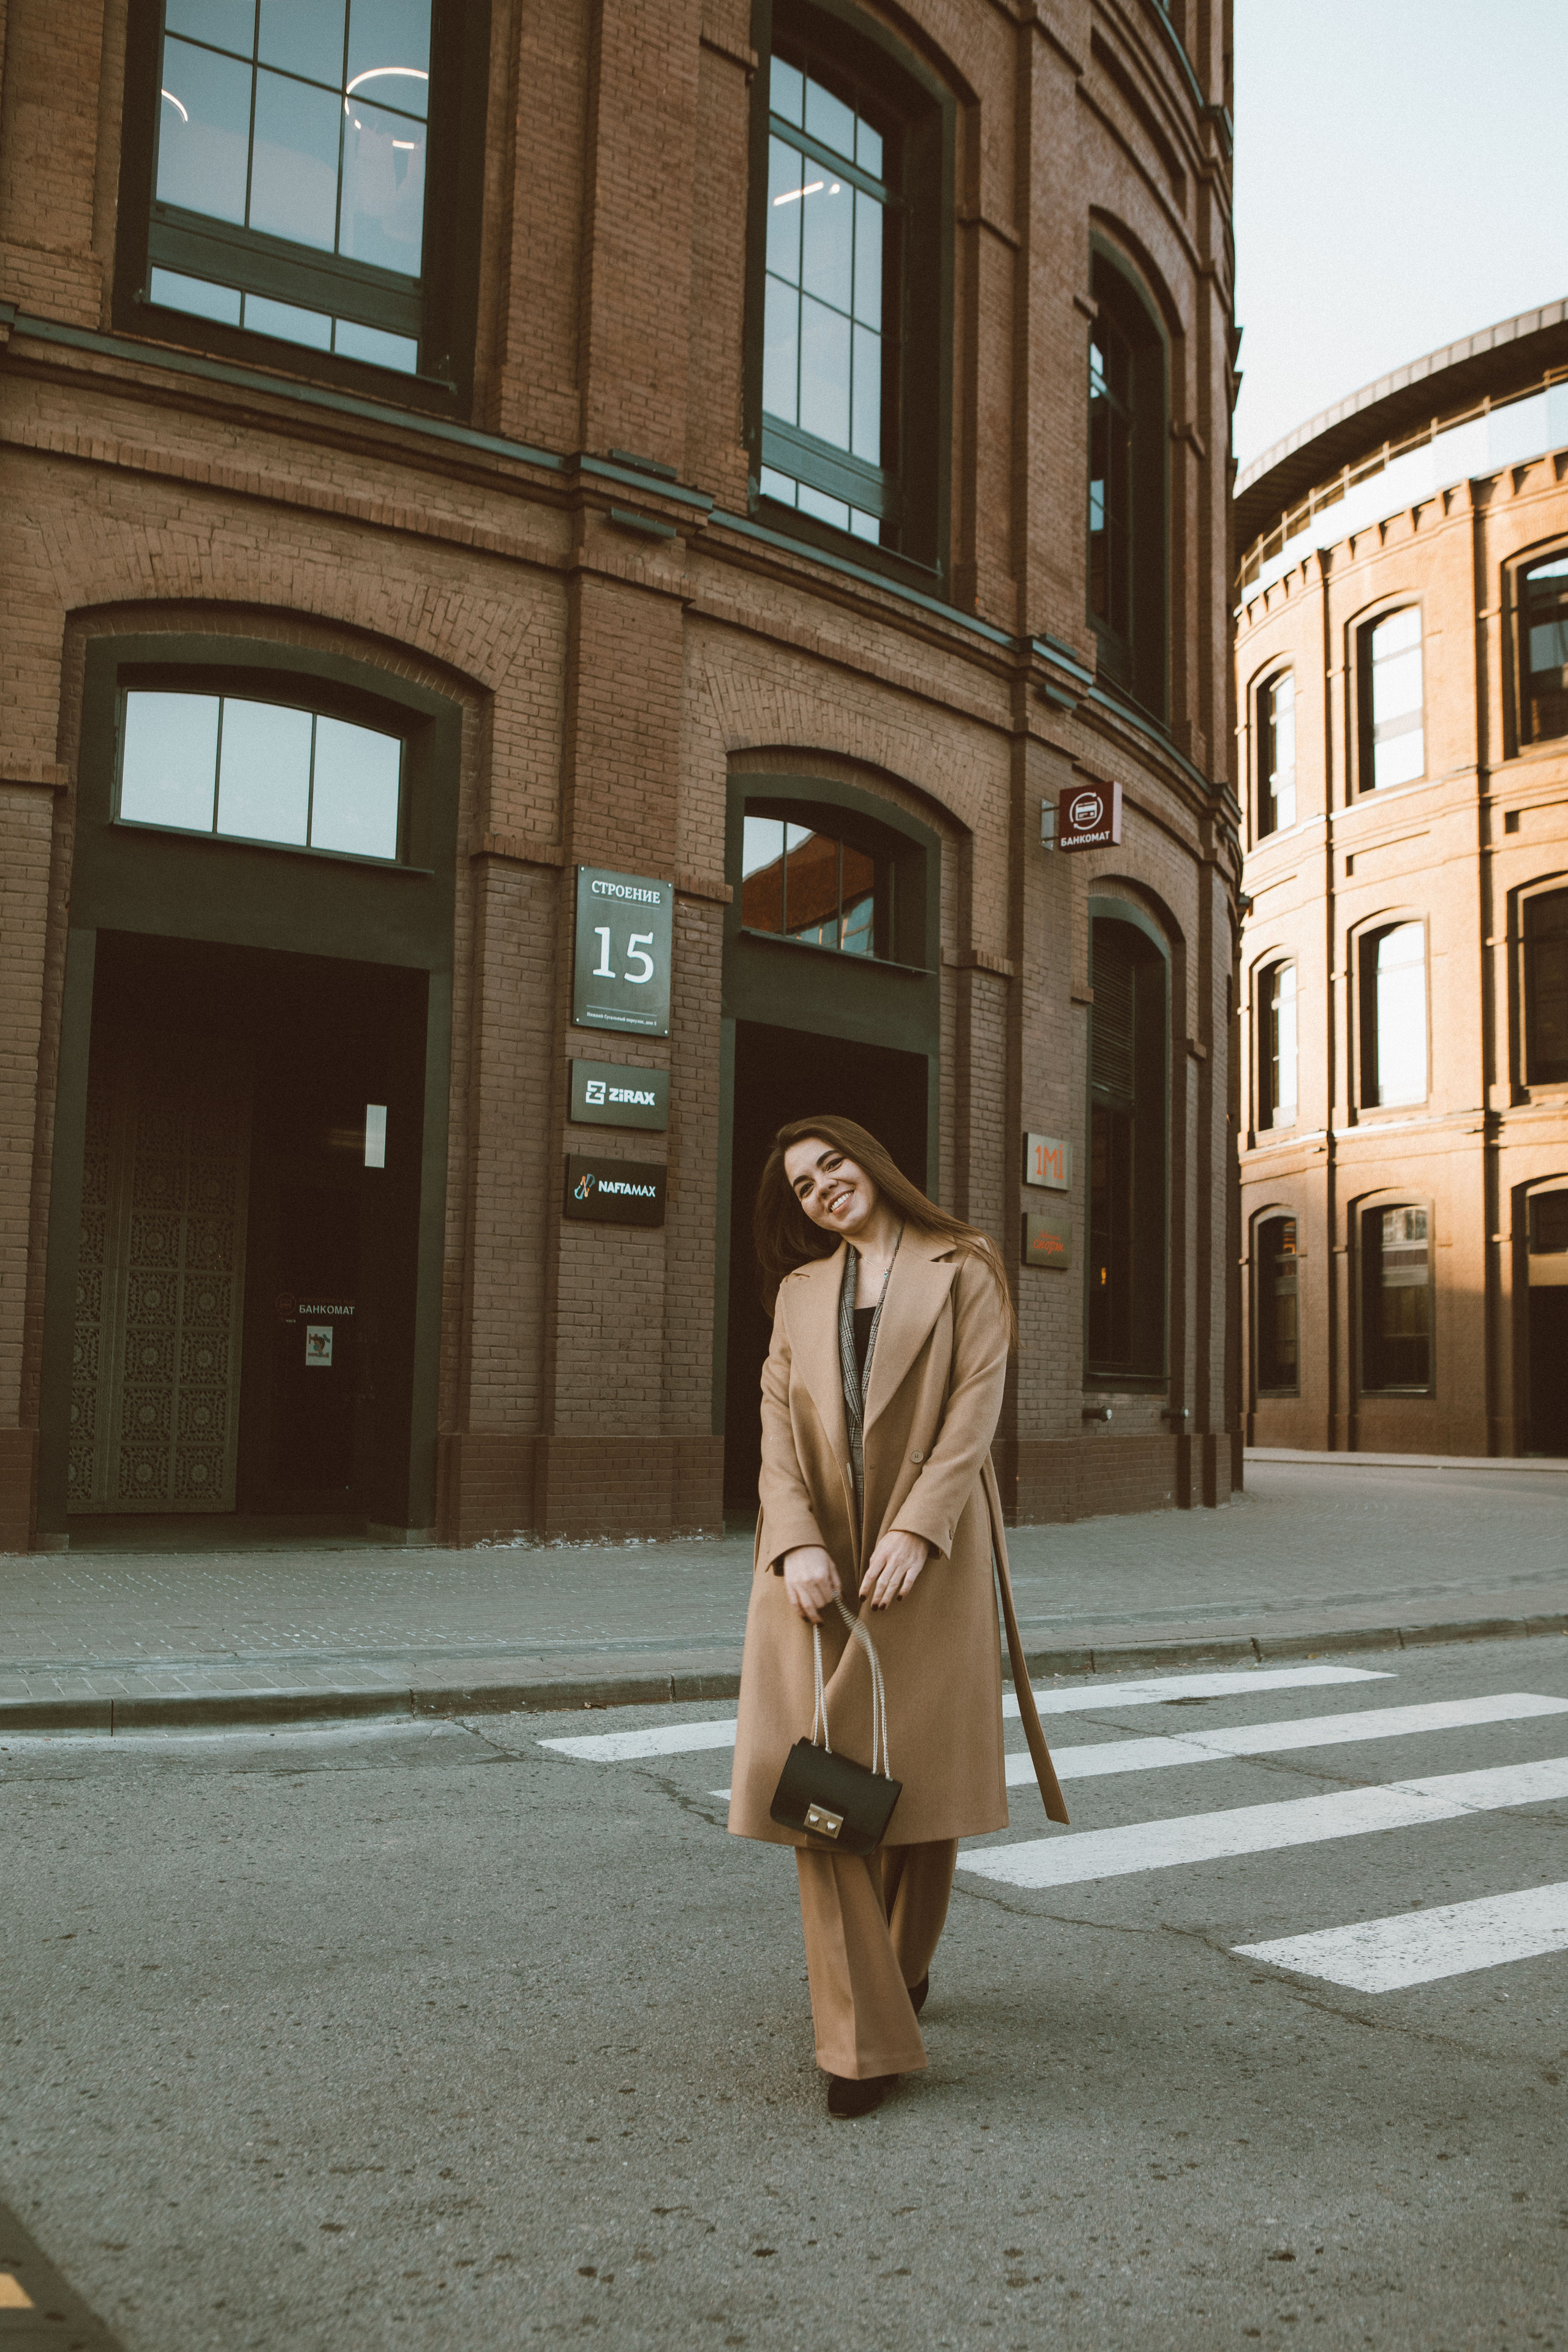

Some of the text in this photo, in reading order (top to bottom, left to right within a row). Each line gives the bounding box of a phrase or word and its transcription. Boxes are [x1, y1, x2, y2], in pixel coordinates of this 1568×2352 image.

[1061, 831, 1110, 846] БАНКОМАТ
[592, 880, 660, 904] СТРОЕНИЕ
[592, 927, 654, 984] 15
[598, 1180, 656, 1197] NAFTAMAX
[299, 1305, 355, 1315] БАНКОМАТ
